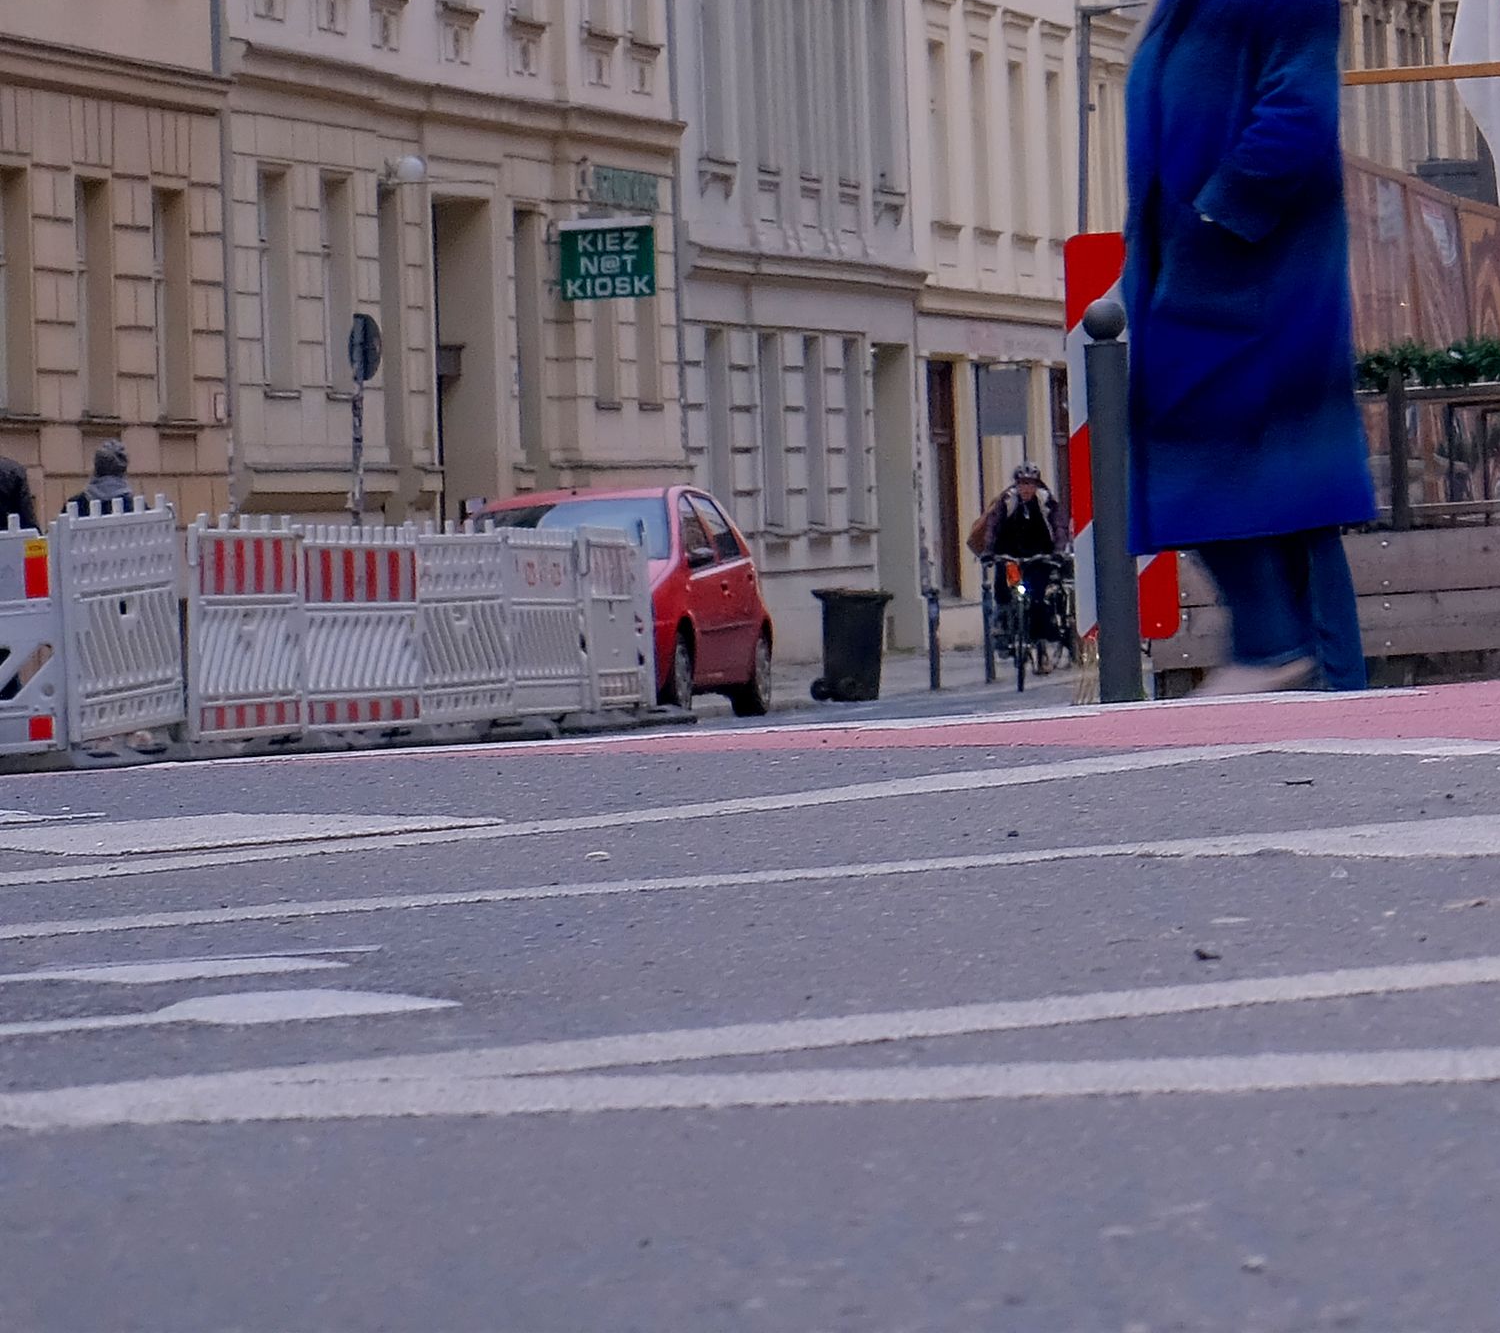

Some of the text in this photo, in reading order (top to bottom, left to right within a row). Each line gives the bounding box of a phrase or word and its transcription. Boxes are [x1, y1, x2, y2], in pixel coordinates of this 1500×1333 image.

[578, 231, 639, 252] KIEZ
[580, 254, 637, 276] N@T
[566, 275, 651, 298] KIOSK
